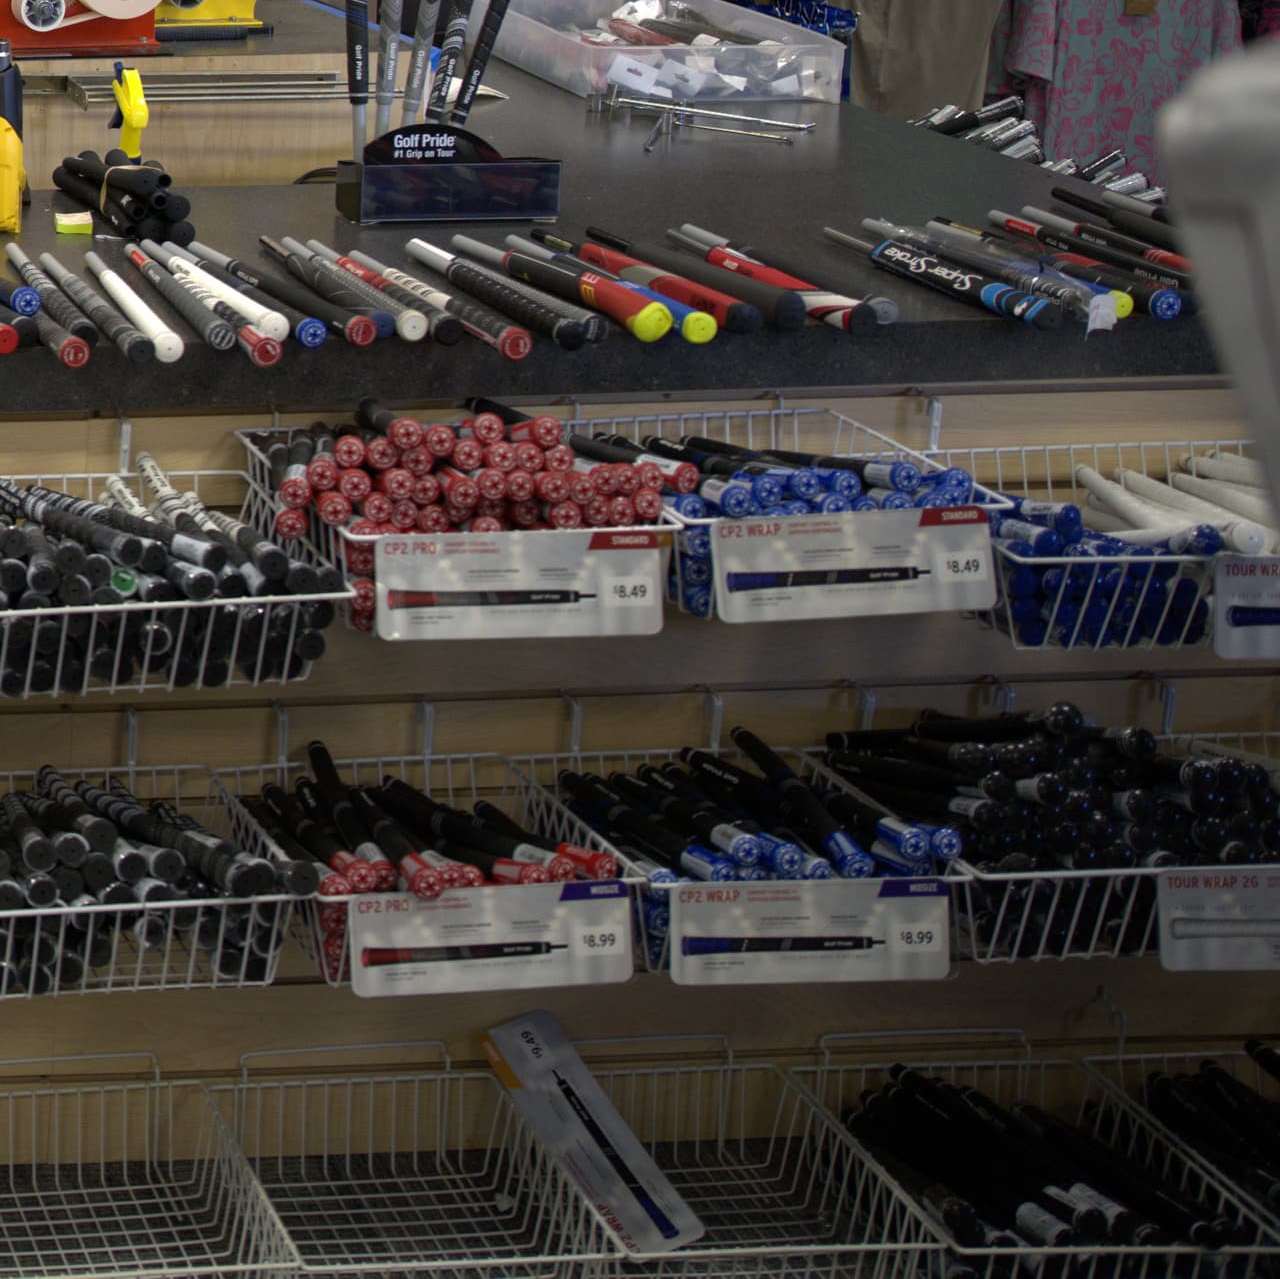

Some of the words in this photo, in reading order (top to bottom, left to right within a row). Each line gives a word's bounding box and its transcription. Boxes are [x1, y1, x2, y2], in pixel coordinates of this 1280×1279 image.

[393, 133, 419, 148] Golf
[421, 133, 455, 147] Pride
[393, 149, 404, 158] #1
[405, 149, 422, 160] Grip
[424, 150, 435, 158] on
[436, 149, 455, 158] Tour
[942, 510, 979, 521] STANDARD
[719, 525, 744, 539] CP2
[747, 523, 781, 538] WRAP
[611, 535, 650, 546] STANDARD
[384, 542, 408, 555] CP2
[412, 541, 436, 555] PRO
[946, 559, 980, 573] $8.49
[1224, 563, 1256, 577] TOUR
[1260, 563, 1280, 577] WR
[613, 584, 647, 599] $8.49
[1167, 876, 1199, 889] TOUR
[1202, 875, 1237, 889] WRAP
[679, 889, 704, 903] CP2
[707, 889, 741, 903] WRAP
[358, 899, 382, 913] CP2
[385, 898, 409, 913] PRO
[582, 932, 616, 949] $8.99
[899, 930, 934, 945] $8.99
[596, 1203, 625, 1233] WRAP
